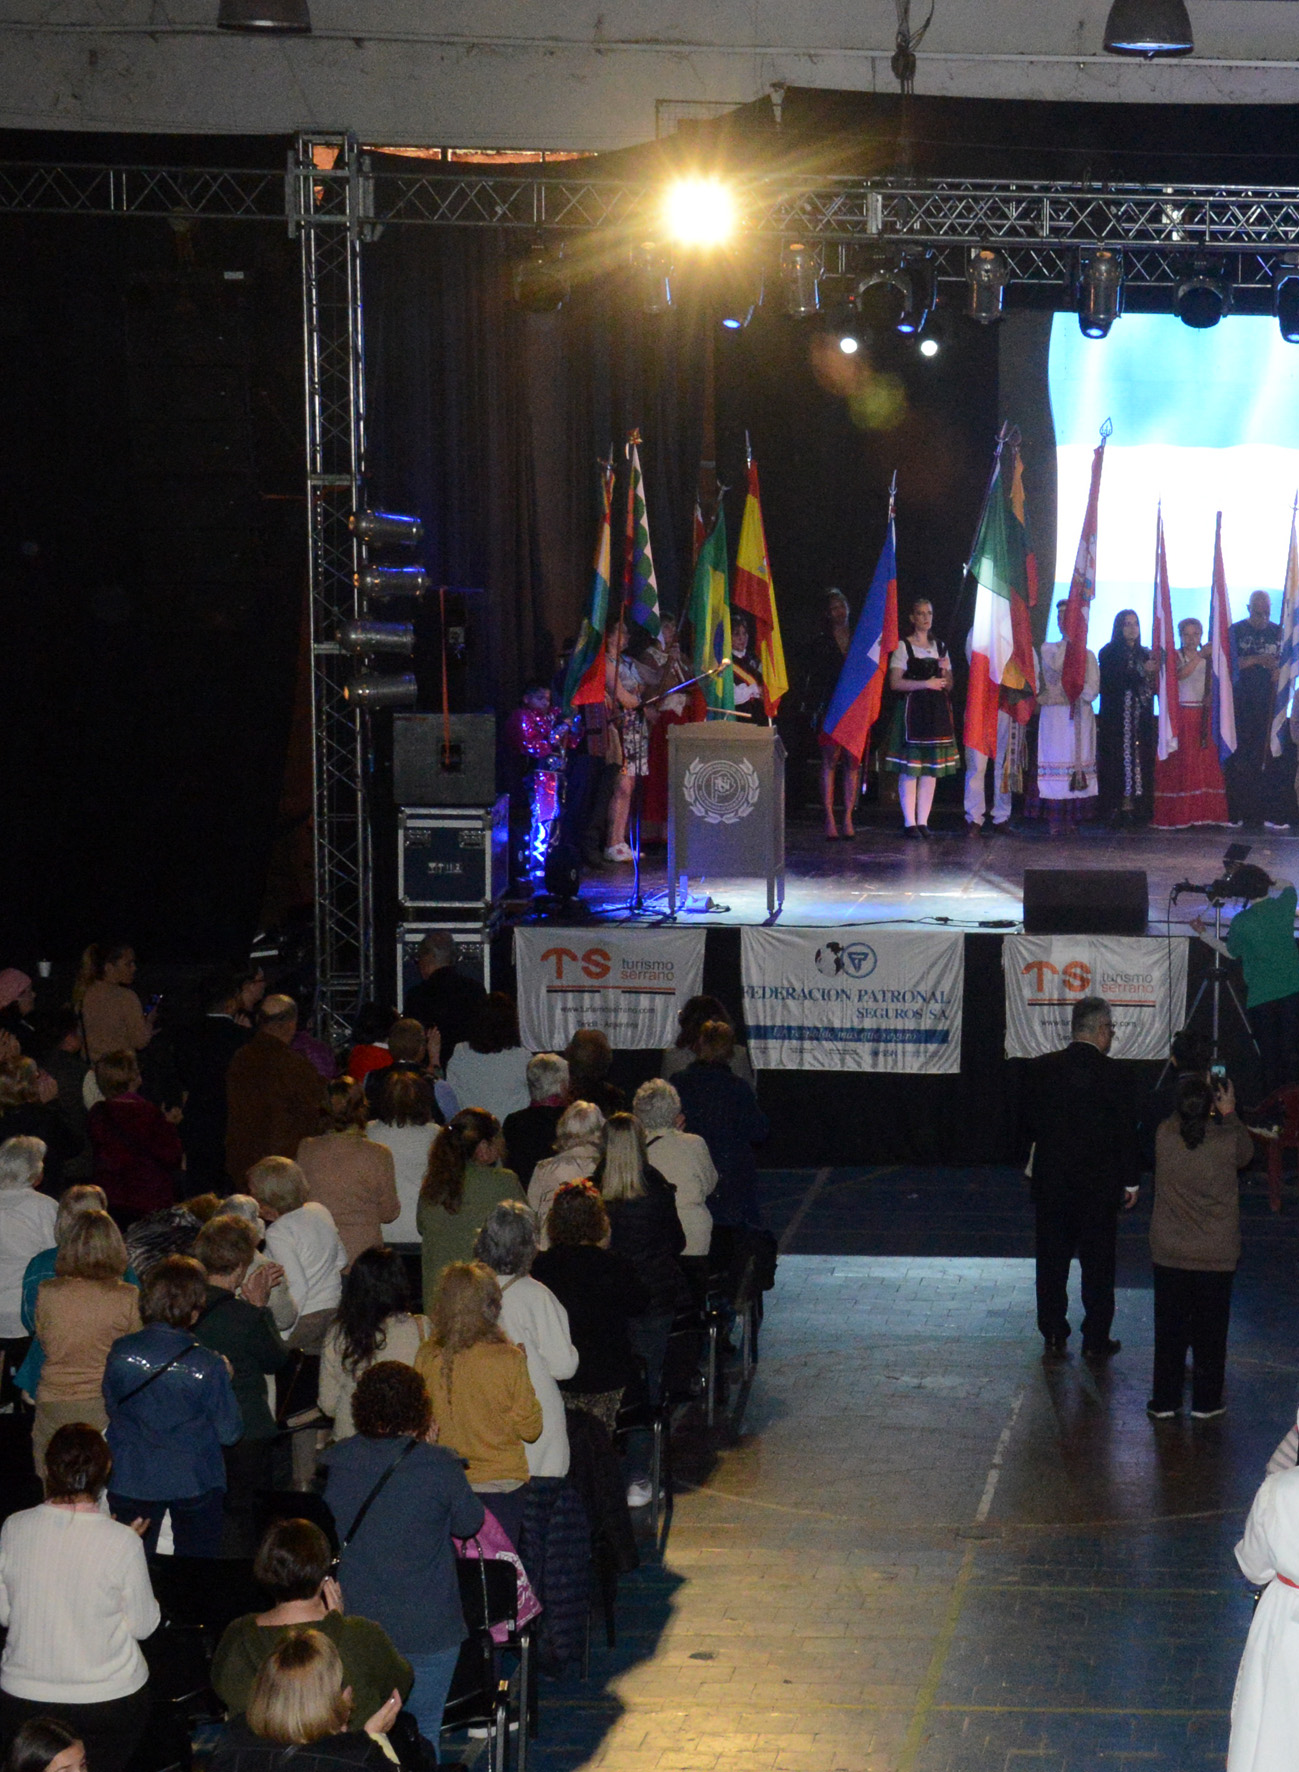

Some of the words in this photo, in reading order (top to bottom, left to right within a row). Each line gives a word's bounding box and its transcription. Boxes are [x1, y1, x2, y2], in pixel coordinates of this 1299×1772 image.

[540, 947, 612, 980] TS
[621, 957, 675, 971] turismo
[620, 969, 675, 981] serrano
[1021, 960, 1092, 993] TS
[1101, 972, 1153, 984] turismo
[1101, 982, 1155, 995] serrano
[856, 989, 951, 1005] PATRONAL
[856, 1007, 923, 1021] SEGUROS
[929, 1007, 949, 1021] SA
